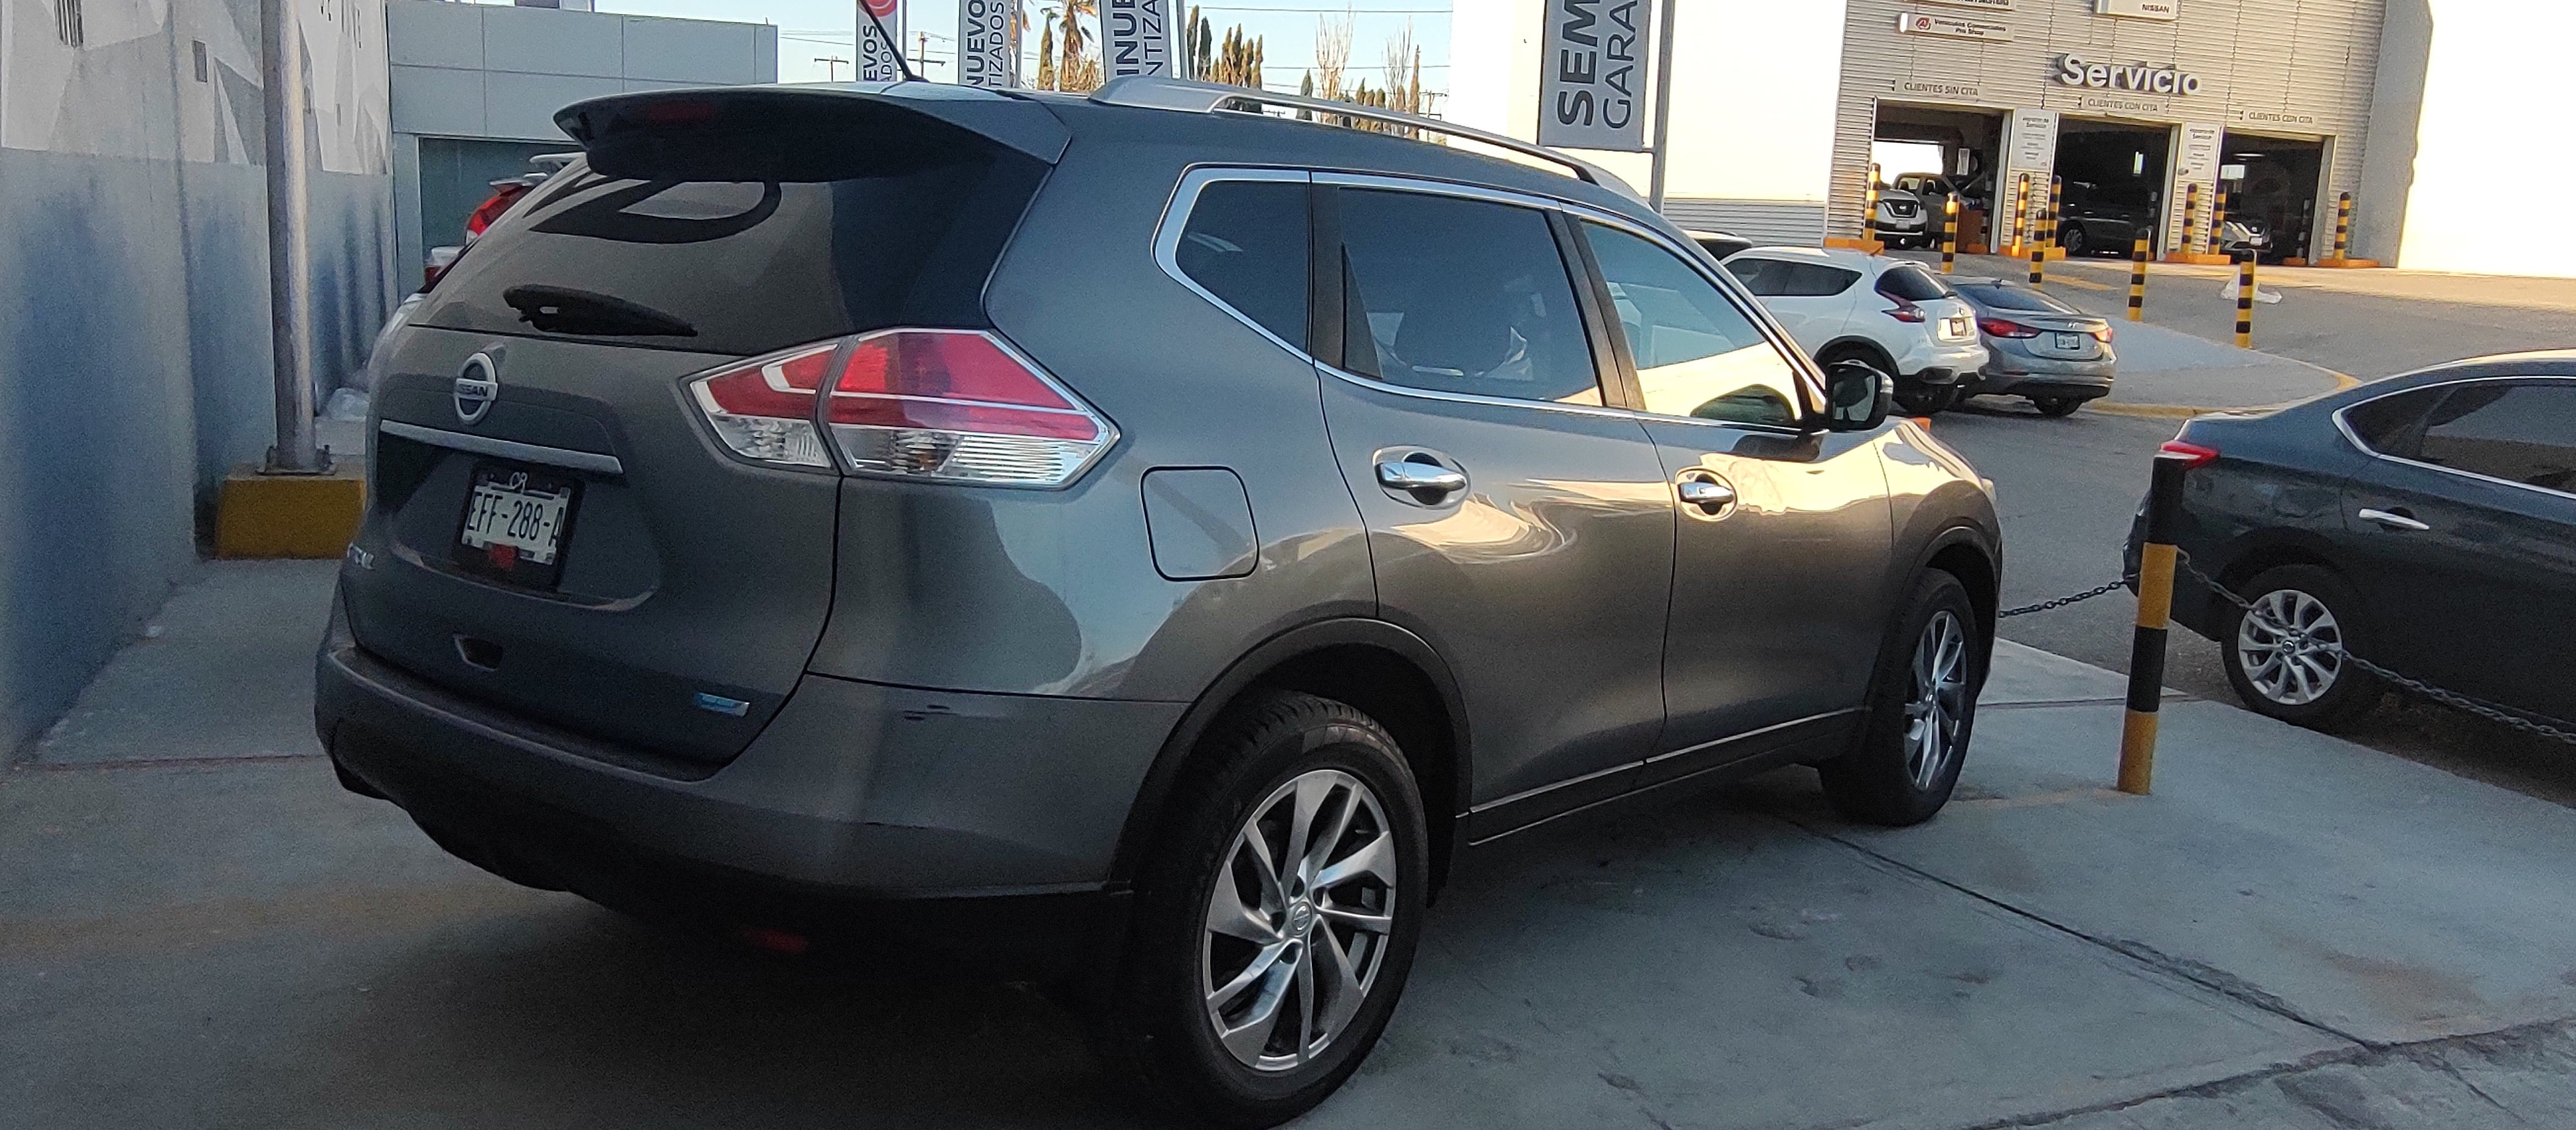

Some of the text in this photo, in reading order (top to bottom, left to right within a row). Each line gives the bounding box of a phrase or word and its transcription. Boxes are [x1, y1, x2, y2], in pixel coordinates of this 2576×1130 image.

[1557, 0, 1600, 126] SEM
[1603, 1, 1638, 129] GARA
[2061, 53, 2203, 95] Servicio
[1904, 82, 1978, 96] CLIENTES SIN CITA
[2087, 98, 2123, 109] CLIENTES
[466, 491, 564, 547] EFF-288-A
